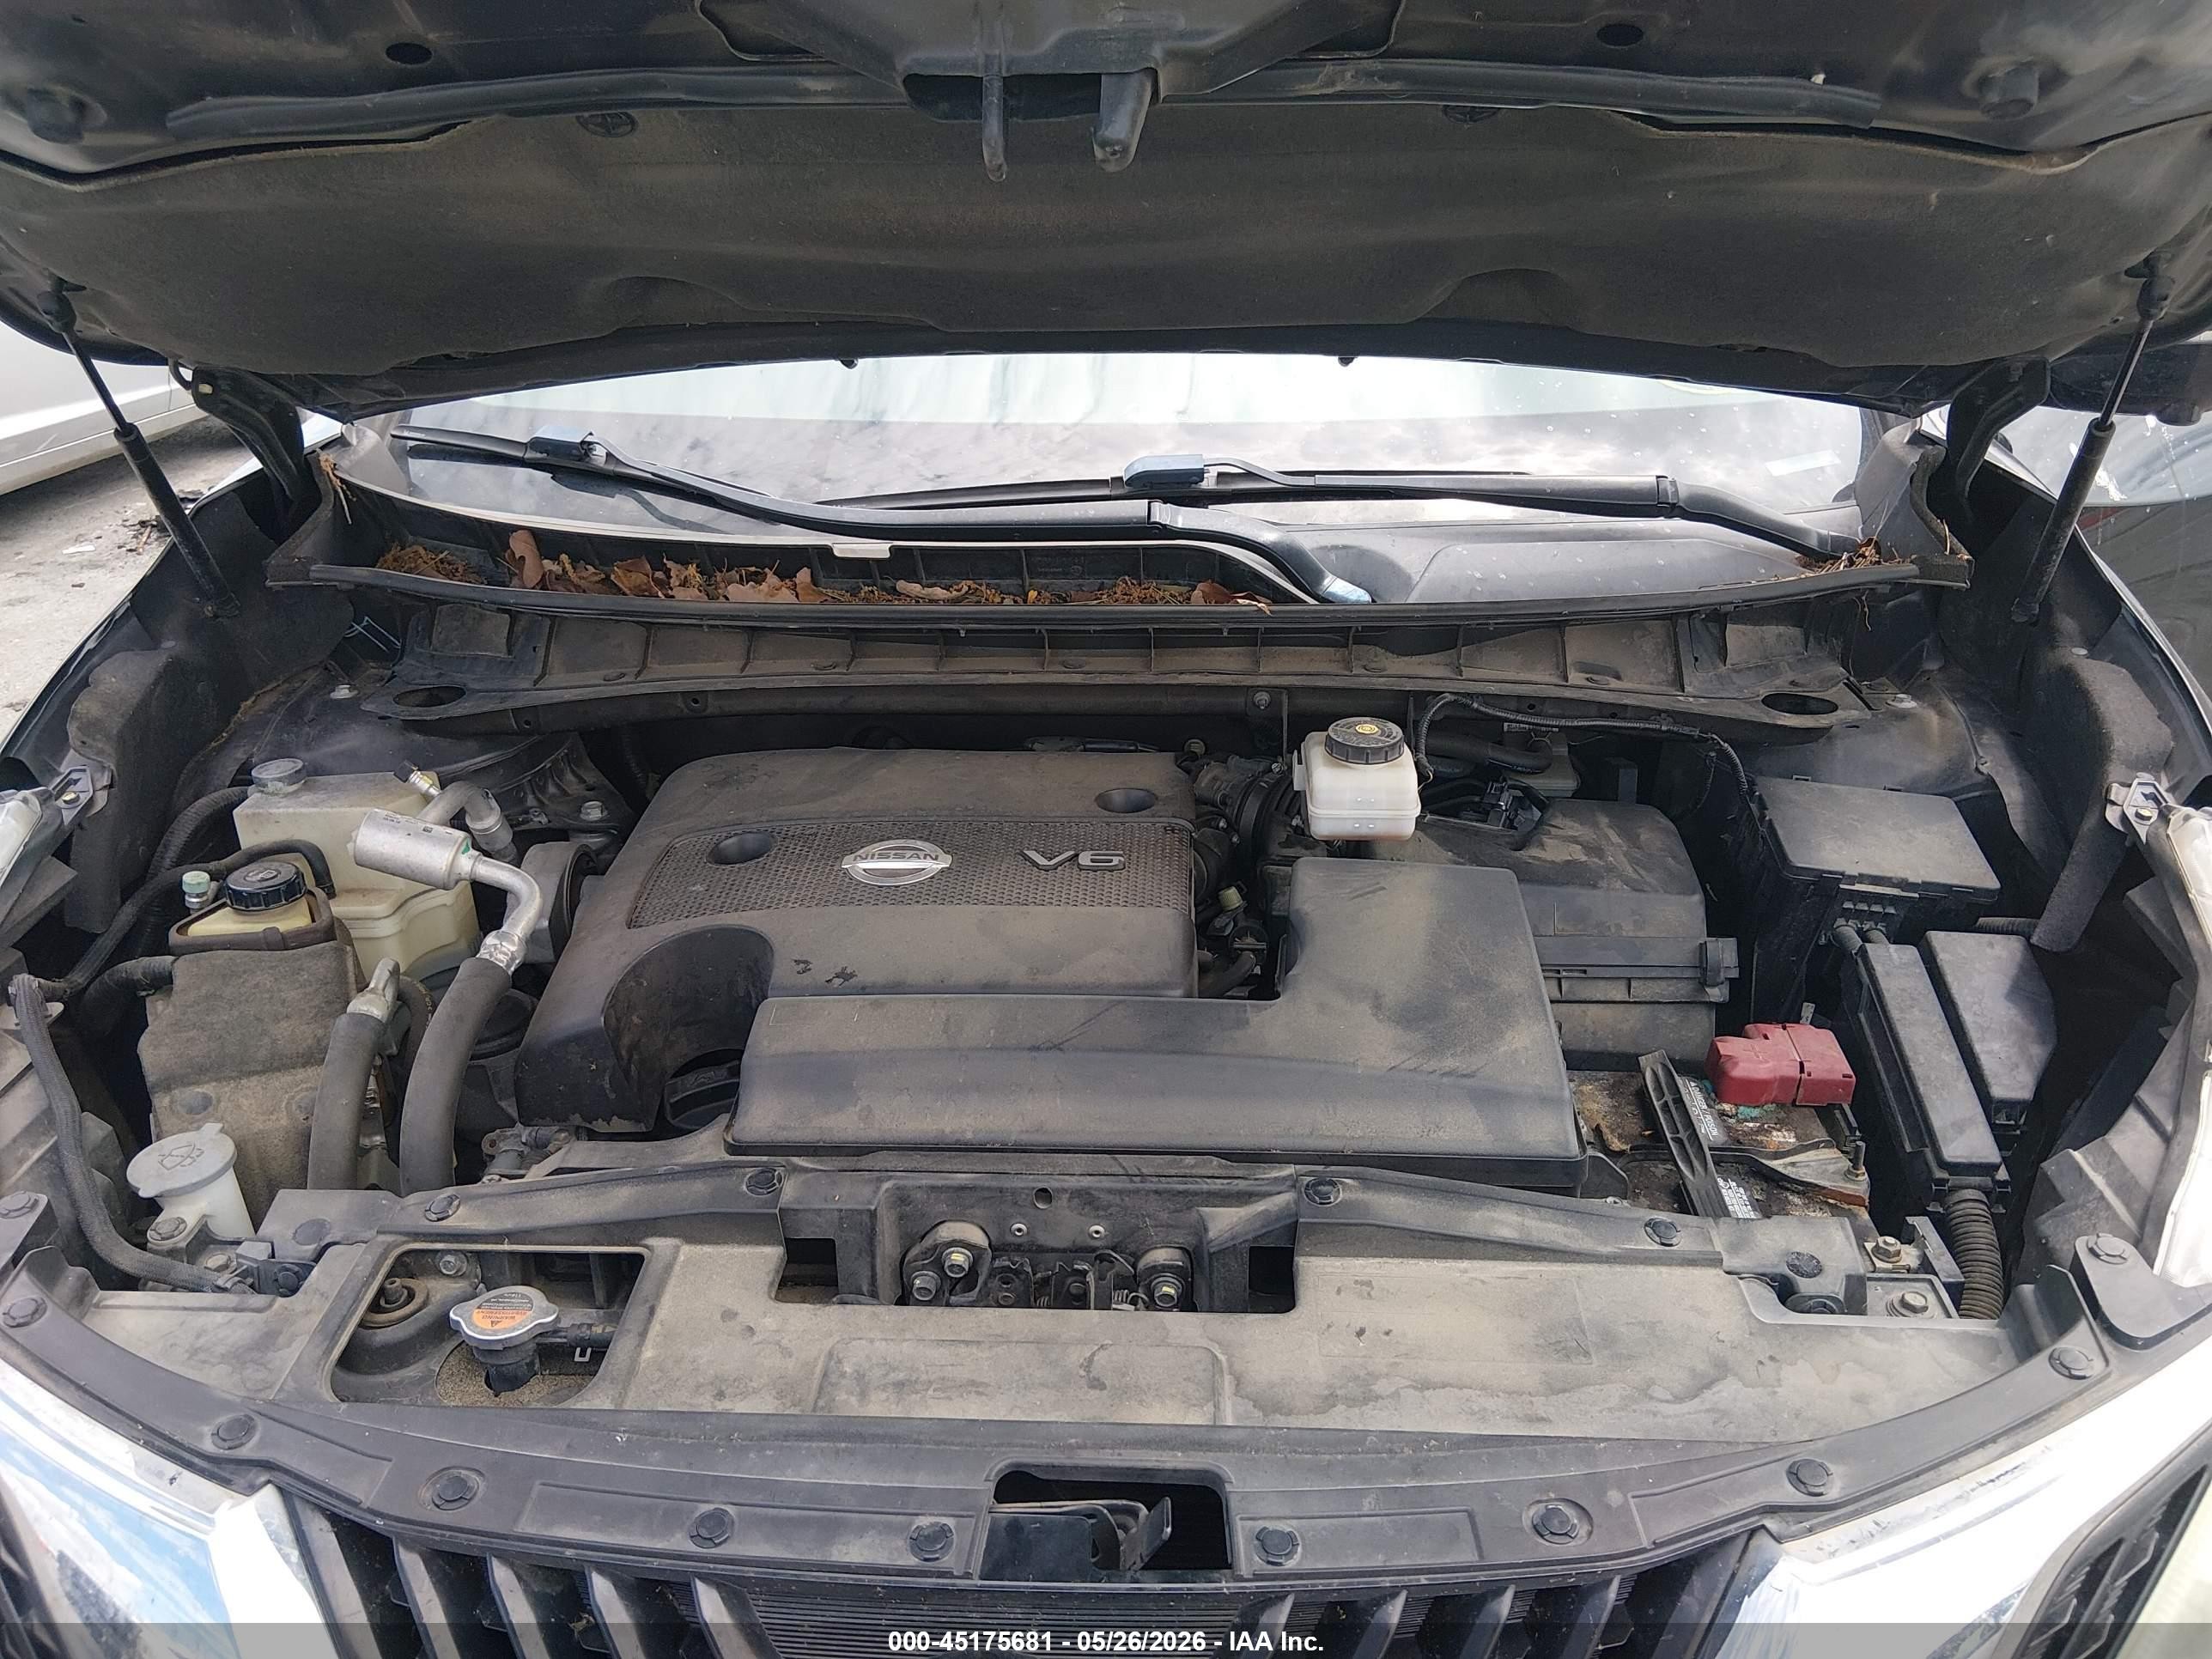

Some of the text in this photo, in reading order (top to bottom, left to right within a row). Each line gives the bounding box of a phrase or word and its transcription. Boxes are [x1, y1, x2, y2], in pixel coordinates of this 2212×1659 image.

[852, 851, 939, 862] NISSAN
[1021, 849, 1126, 868] V6
[1692, 1086, 1708, 1109] DANGER
[1703, 1114, 1718, 1136] POISON
